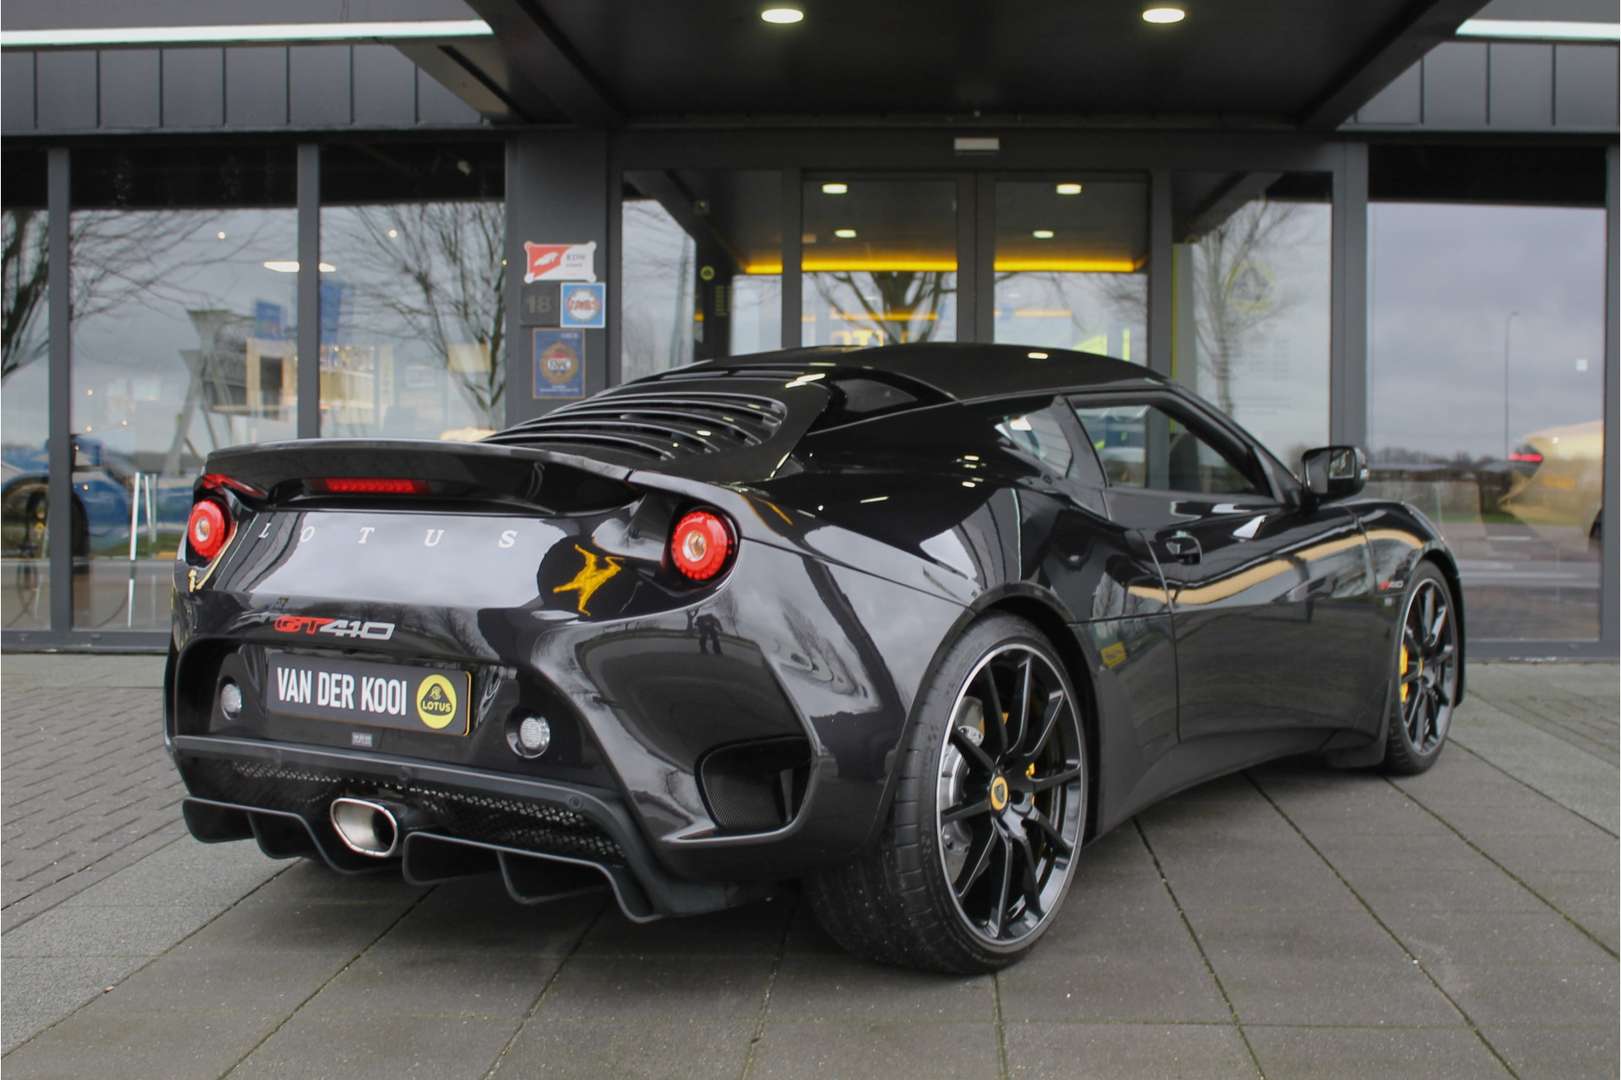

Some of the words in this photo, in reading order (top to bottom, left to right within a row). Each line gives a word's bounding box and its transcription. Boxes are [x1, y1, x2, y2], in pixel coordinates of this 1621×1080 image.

[258, 522, 518, 548] LOTUS
[274, 614, 396, 640] GT410
[277, 667, 312, 704] VAN
[317, 671, 355, 710] DER
[361, 676, 407, 716] KOOI
[422, 700, 452, 712] LOTUS
